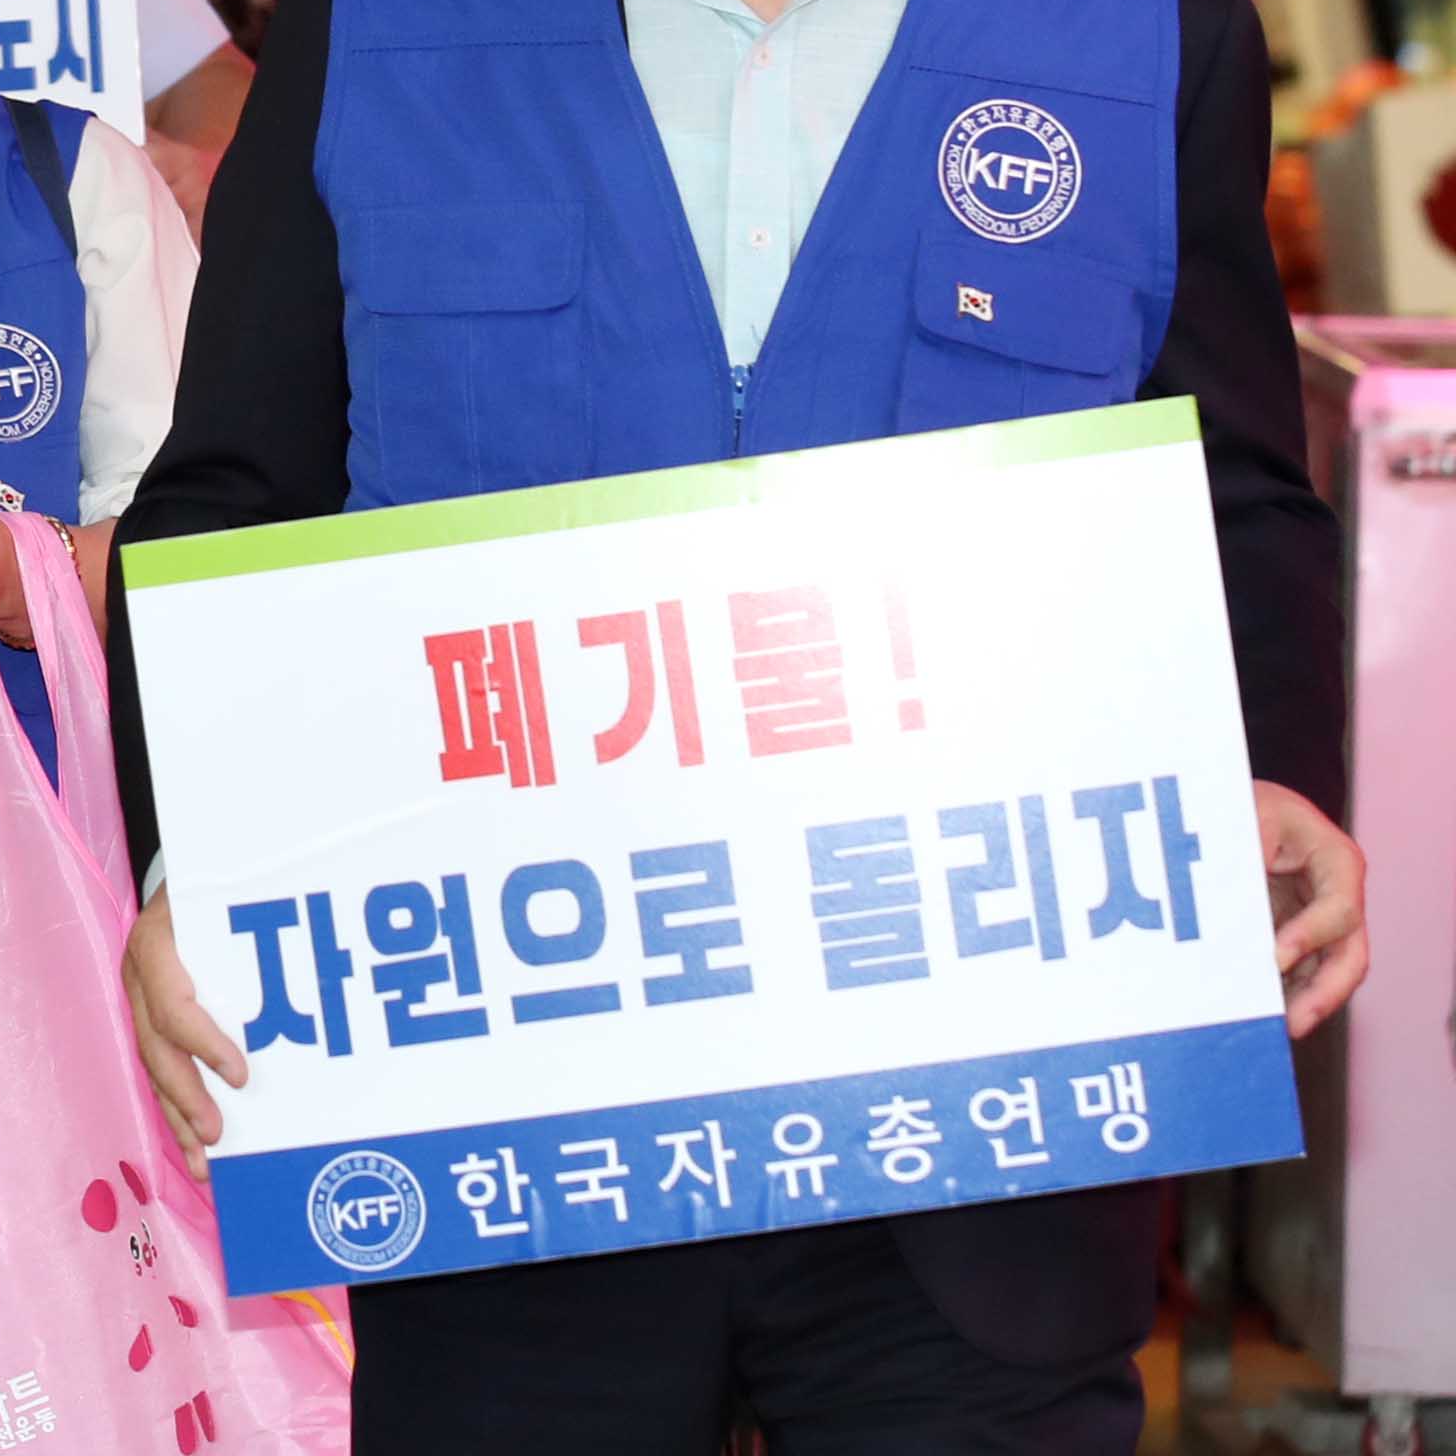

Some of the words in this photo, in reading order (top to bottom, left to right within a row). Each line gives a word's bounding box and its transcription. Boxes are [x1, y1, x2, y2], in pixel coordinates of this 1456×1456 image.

[968, 147, 1055, 195] KFF
[422, 586, 927, 789] 폐기물!
[229, 840, 755, 1058] 자원으로
[804, 775, 1201, 992] 돌리자
[332, 1194, 400, 1232] KFF
[450, 1062, 1151, 1239] 한국자유총연맹
